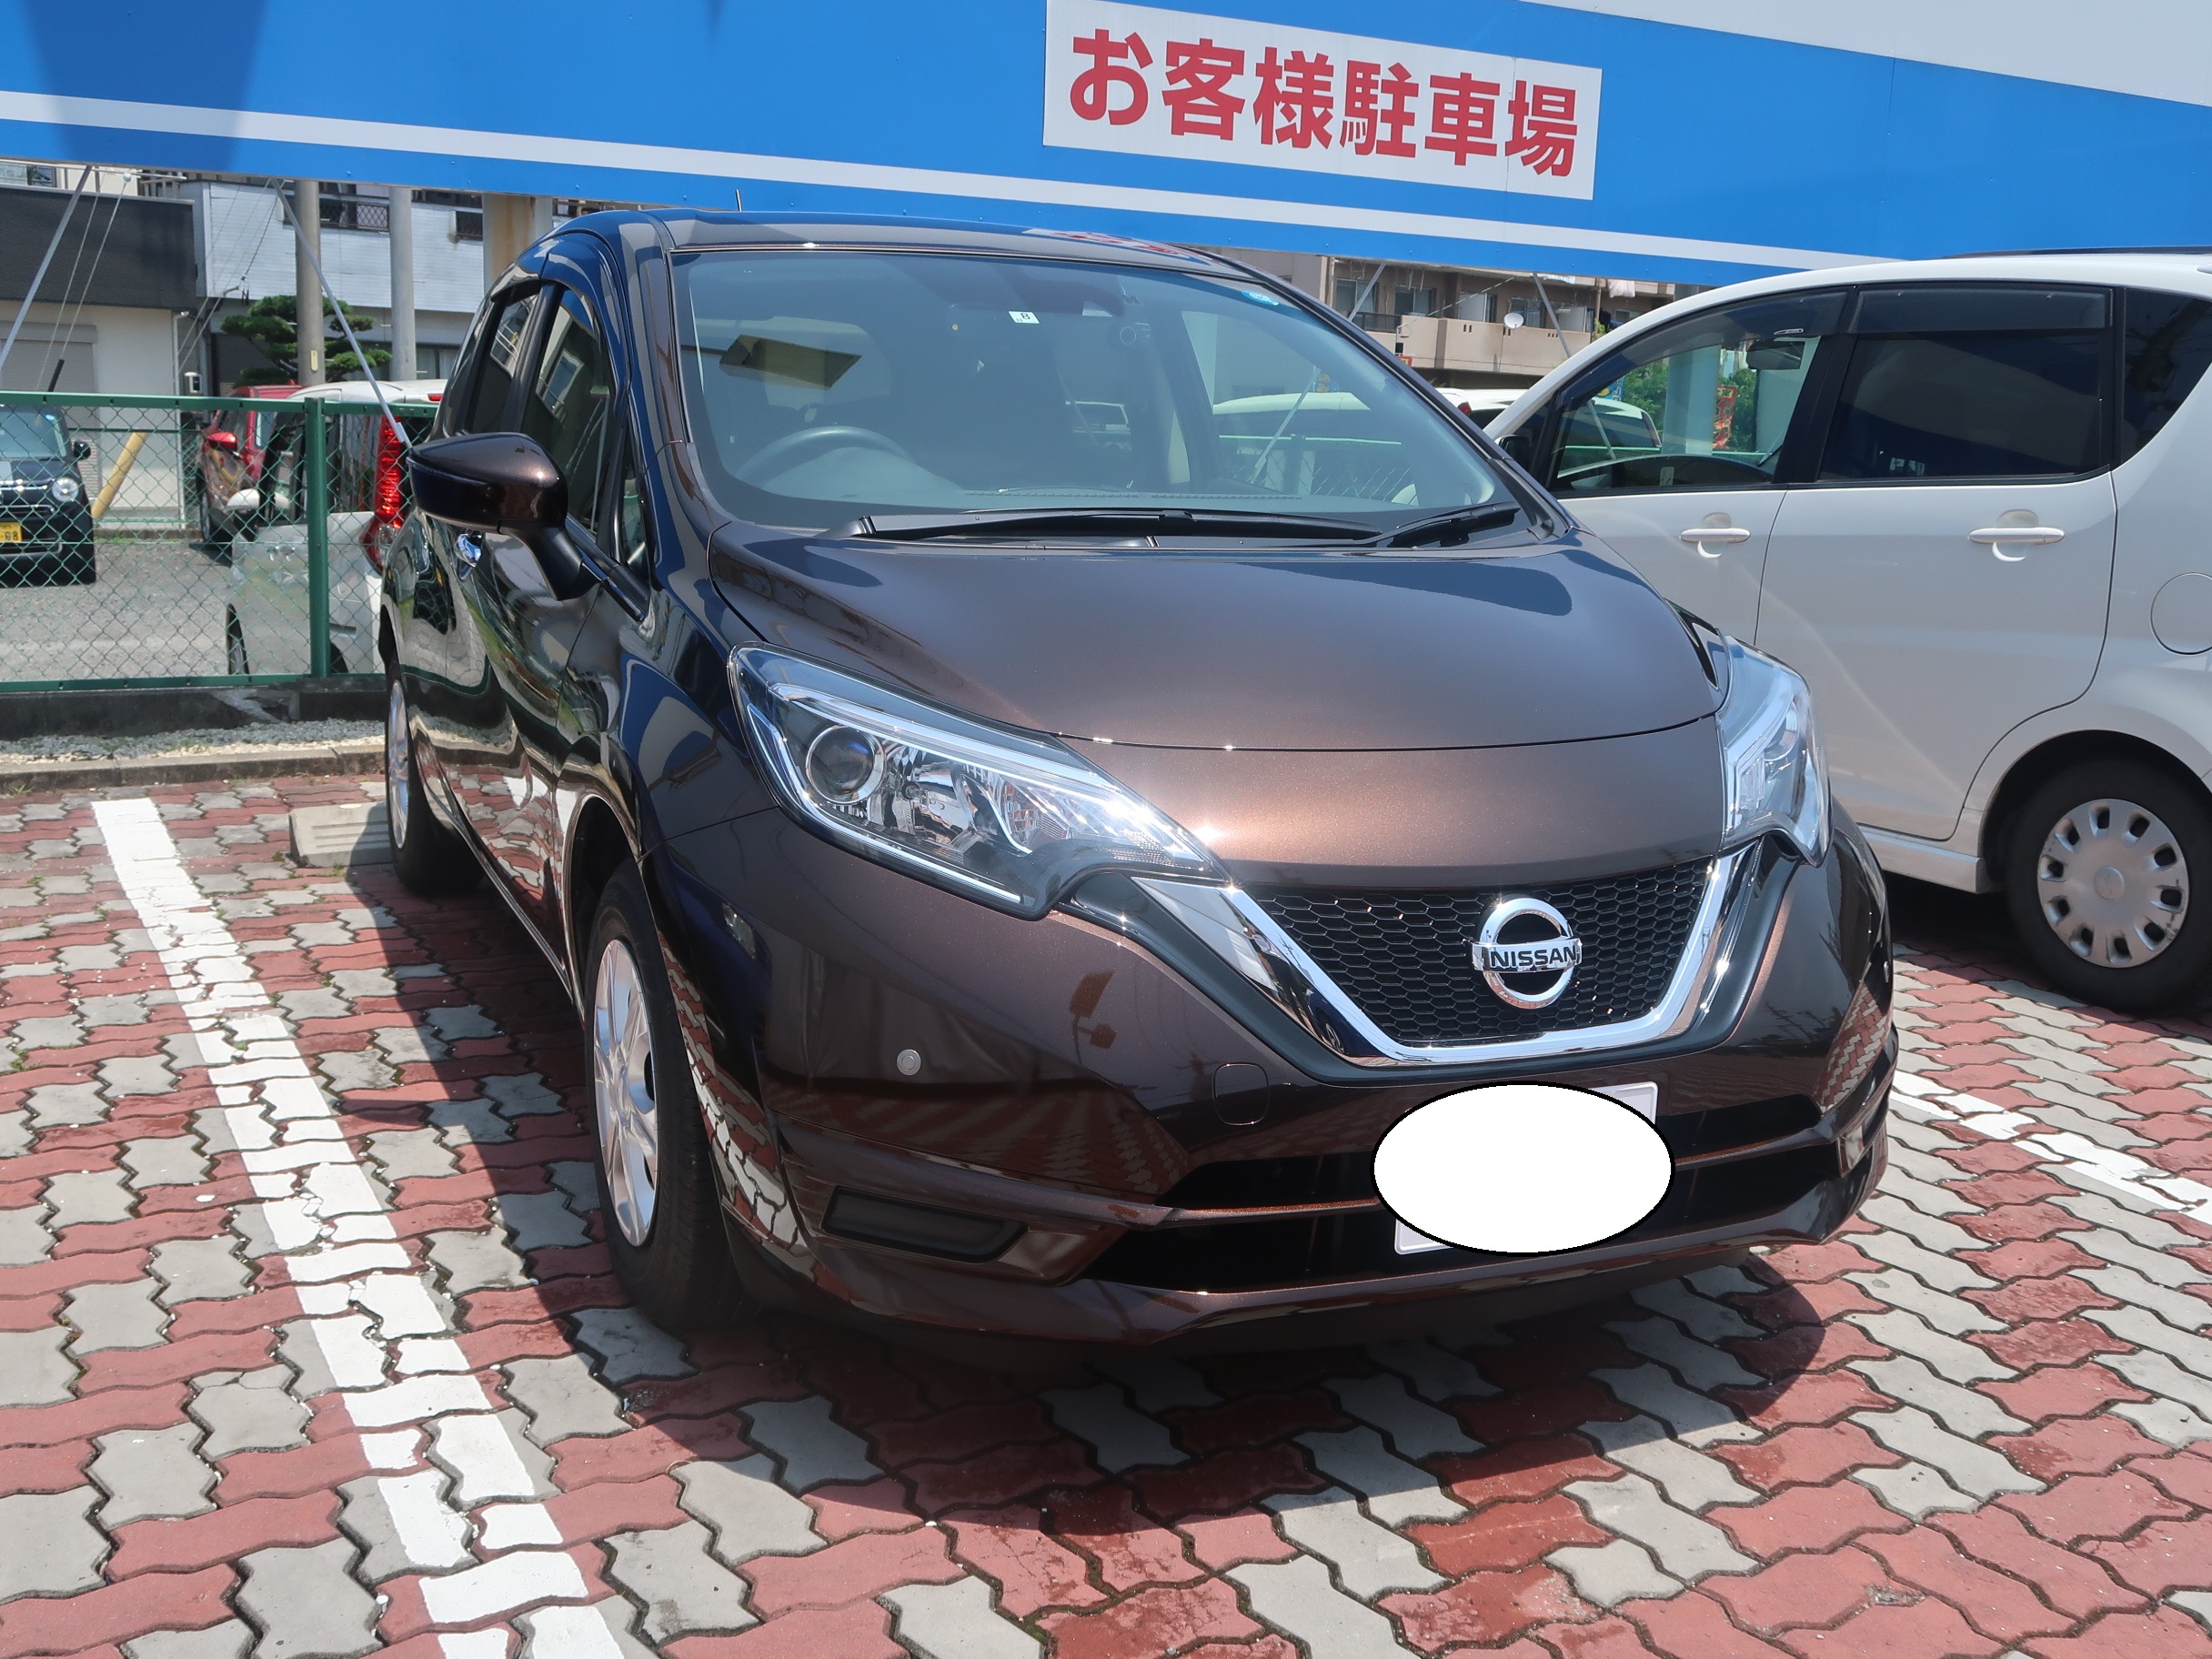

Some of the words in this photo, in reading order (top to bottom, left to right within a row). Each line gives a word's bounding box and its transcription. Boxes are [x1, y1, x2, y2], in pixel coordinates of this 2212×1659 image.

[1070, 28, 1578, 177] お客様駐車場
[1020, 312, 1031, 320] 8
[1489, 945, 1577, 968] NISSAN
